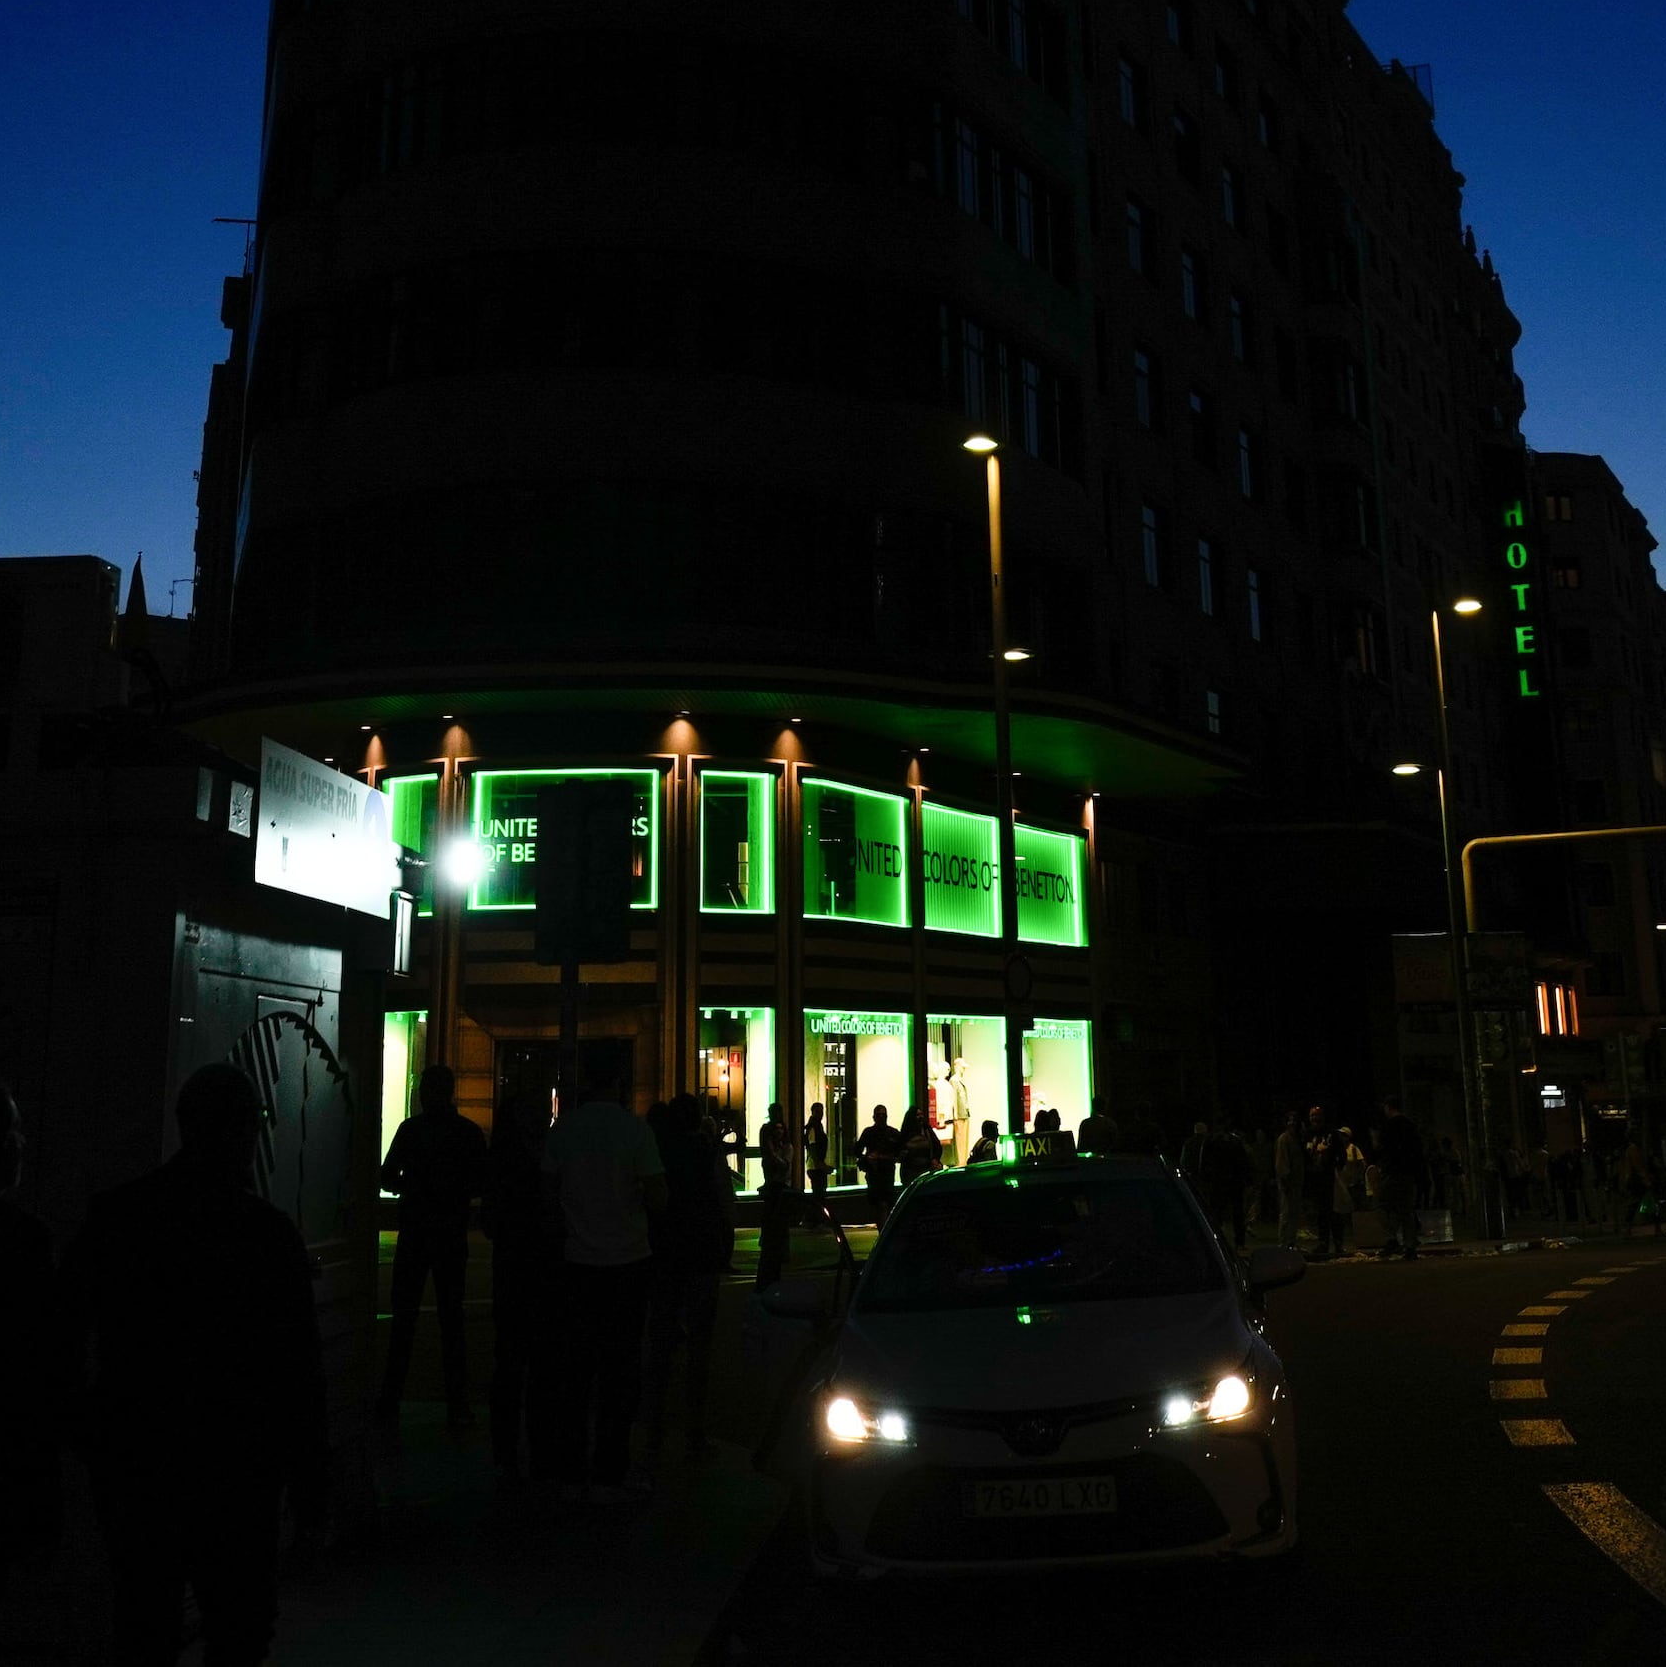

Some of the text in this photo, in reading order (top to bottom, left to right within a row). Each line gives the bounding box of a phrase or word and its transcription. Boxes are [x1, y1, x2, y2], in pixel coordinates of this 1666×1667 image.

[1504, 500, 1539, 697] HOTEL
[300, 771, 334, 814] SUPER
[336, 782, 357, 823] FRÍA
[480, 817, 538, 838] UNITE
[923, 849, 978, 889] COLORS
[811, 1018, 841, 1034] UNITED
[1016, 1137, 1052, 1158] TAXI
[983, 1482, 1111, 1512] 7640 LXG
